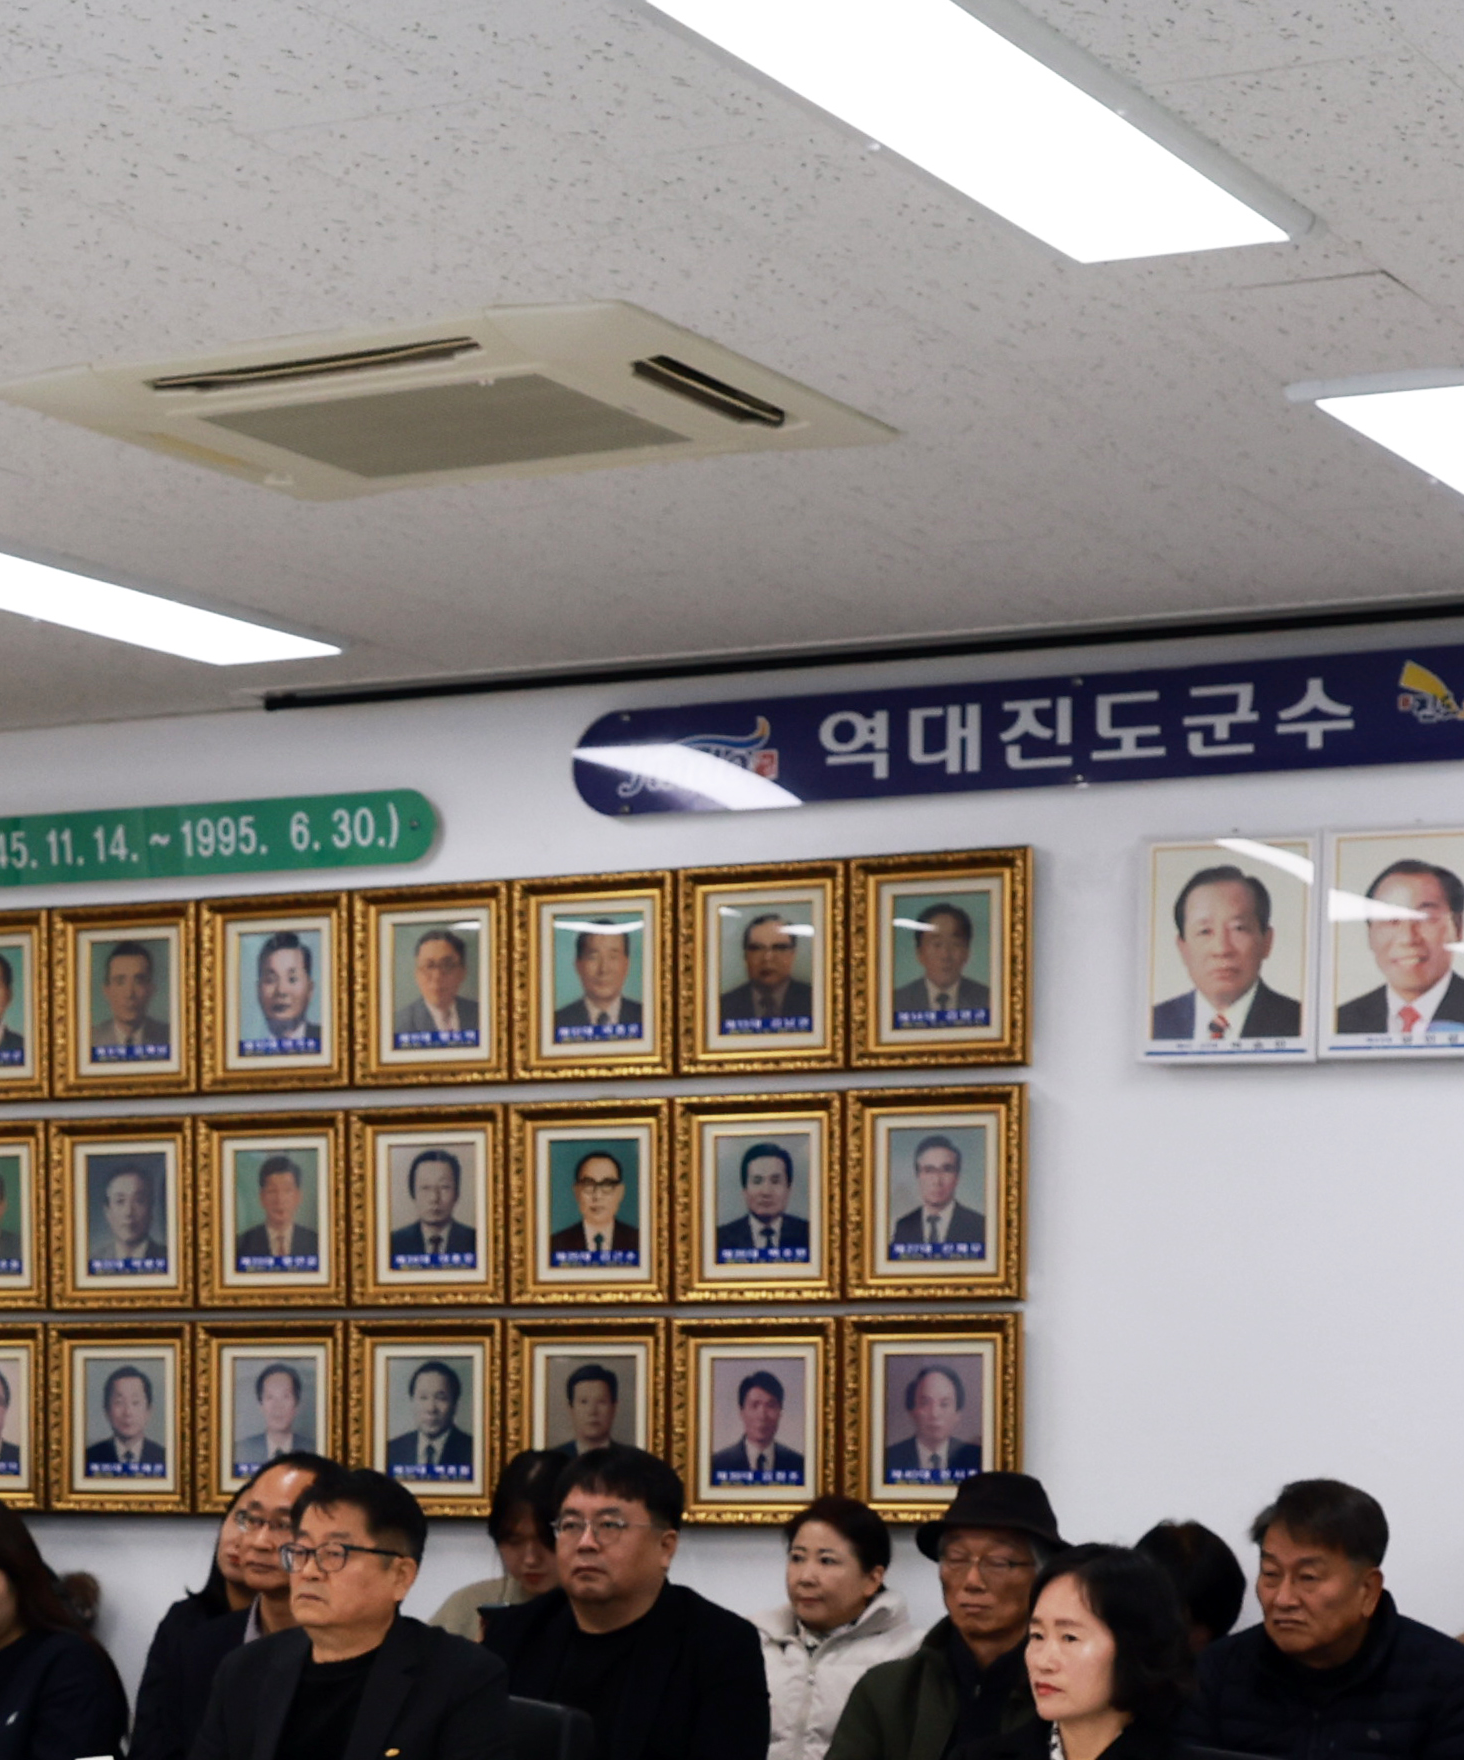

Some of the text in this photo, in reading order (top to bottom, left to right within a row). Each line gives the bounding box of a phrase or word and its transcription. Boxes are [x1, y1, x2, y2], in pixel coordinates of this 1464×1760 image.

[819, 677, 1355, 780] 역대진도군수
[181, 816, 269, 860] 1995.
[290, 811, 321, 852] 6.
[332, 803, 401, 849] 30.)
